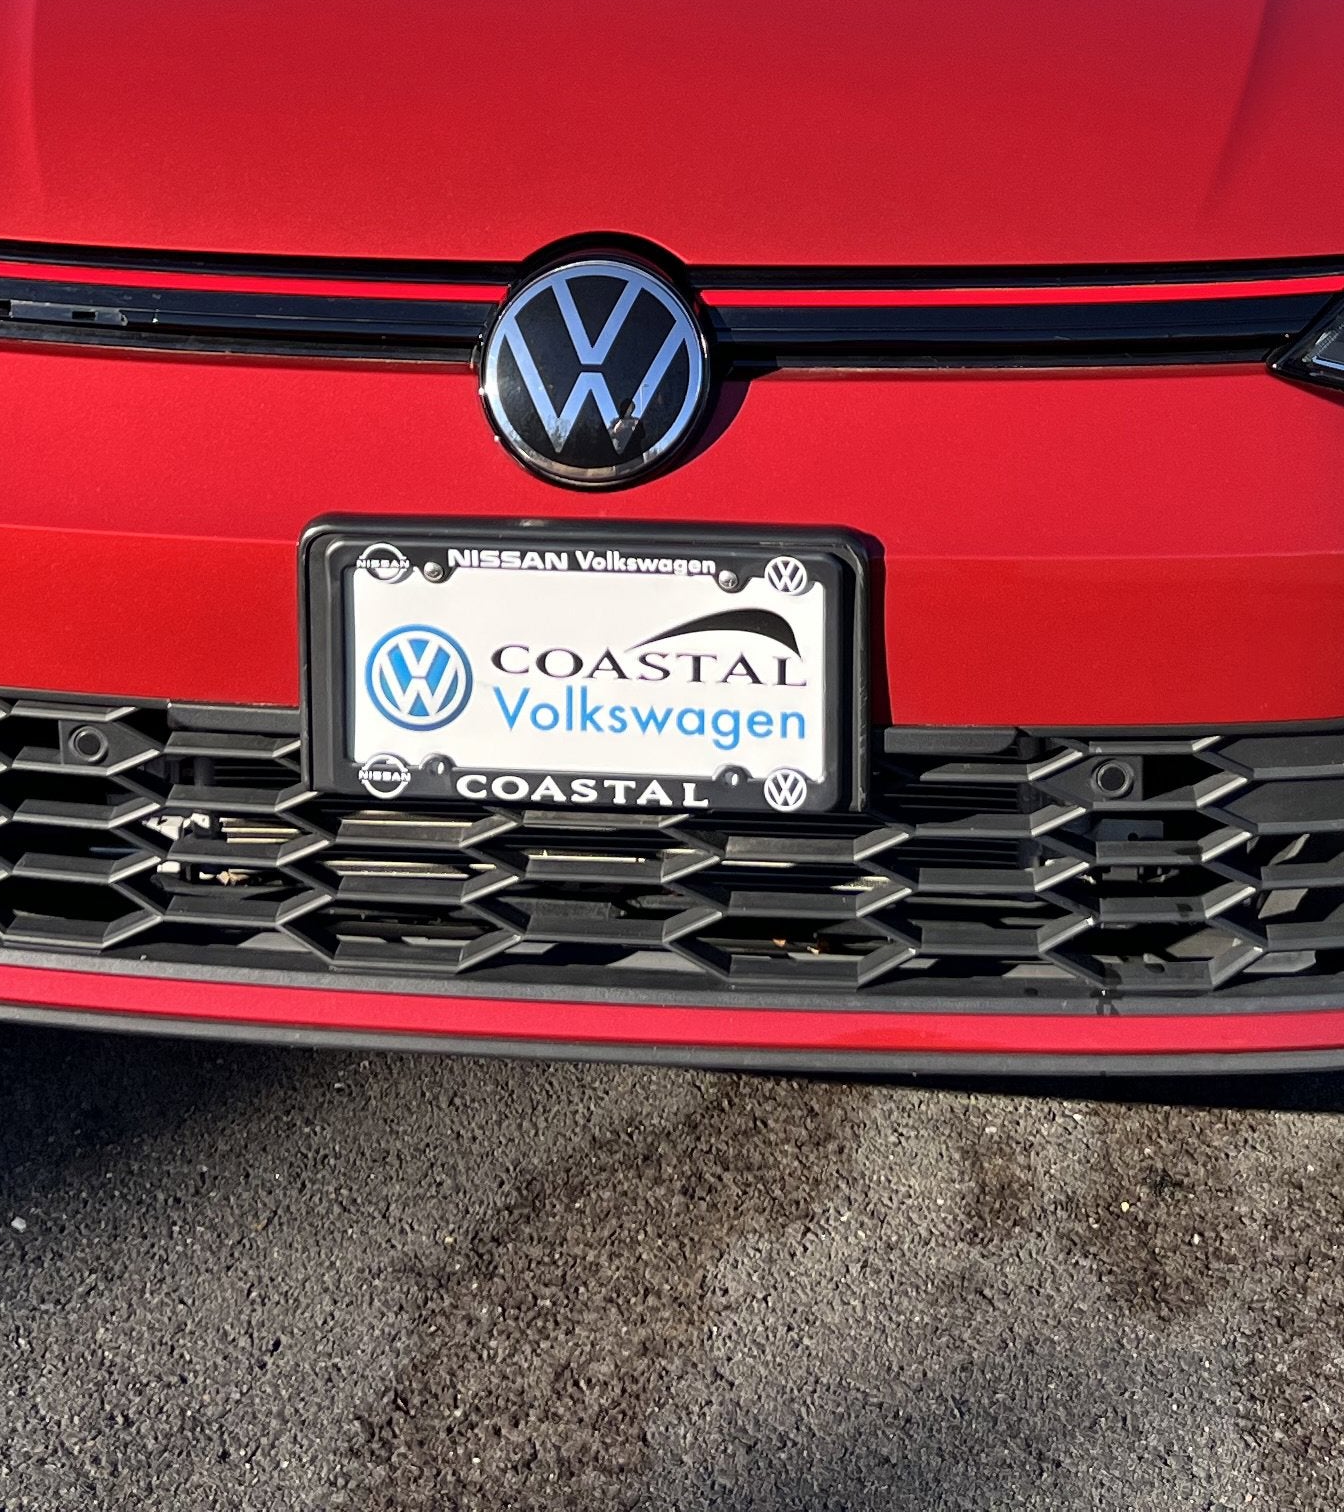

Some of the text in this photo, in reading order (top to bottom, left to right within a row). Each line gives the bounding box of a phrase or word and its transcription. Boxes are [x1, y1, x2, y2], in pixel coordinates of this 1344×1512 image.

[356, 558, 409, 570] NISSAN
[448, 549, 716, 576] NISSAN Volkswagen
[490, 645, 807, 687] COASTAL
[494, 685, 805, 751] Volkswagen
[358, 770, 411, 783] NISSAN
[456, 775, 709, 807] COASTAL
